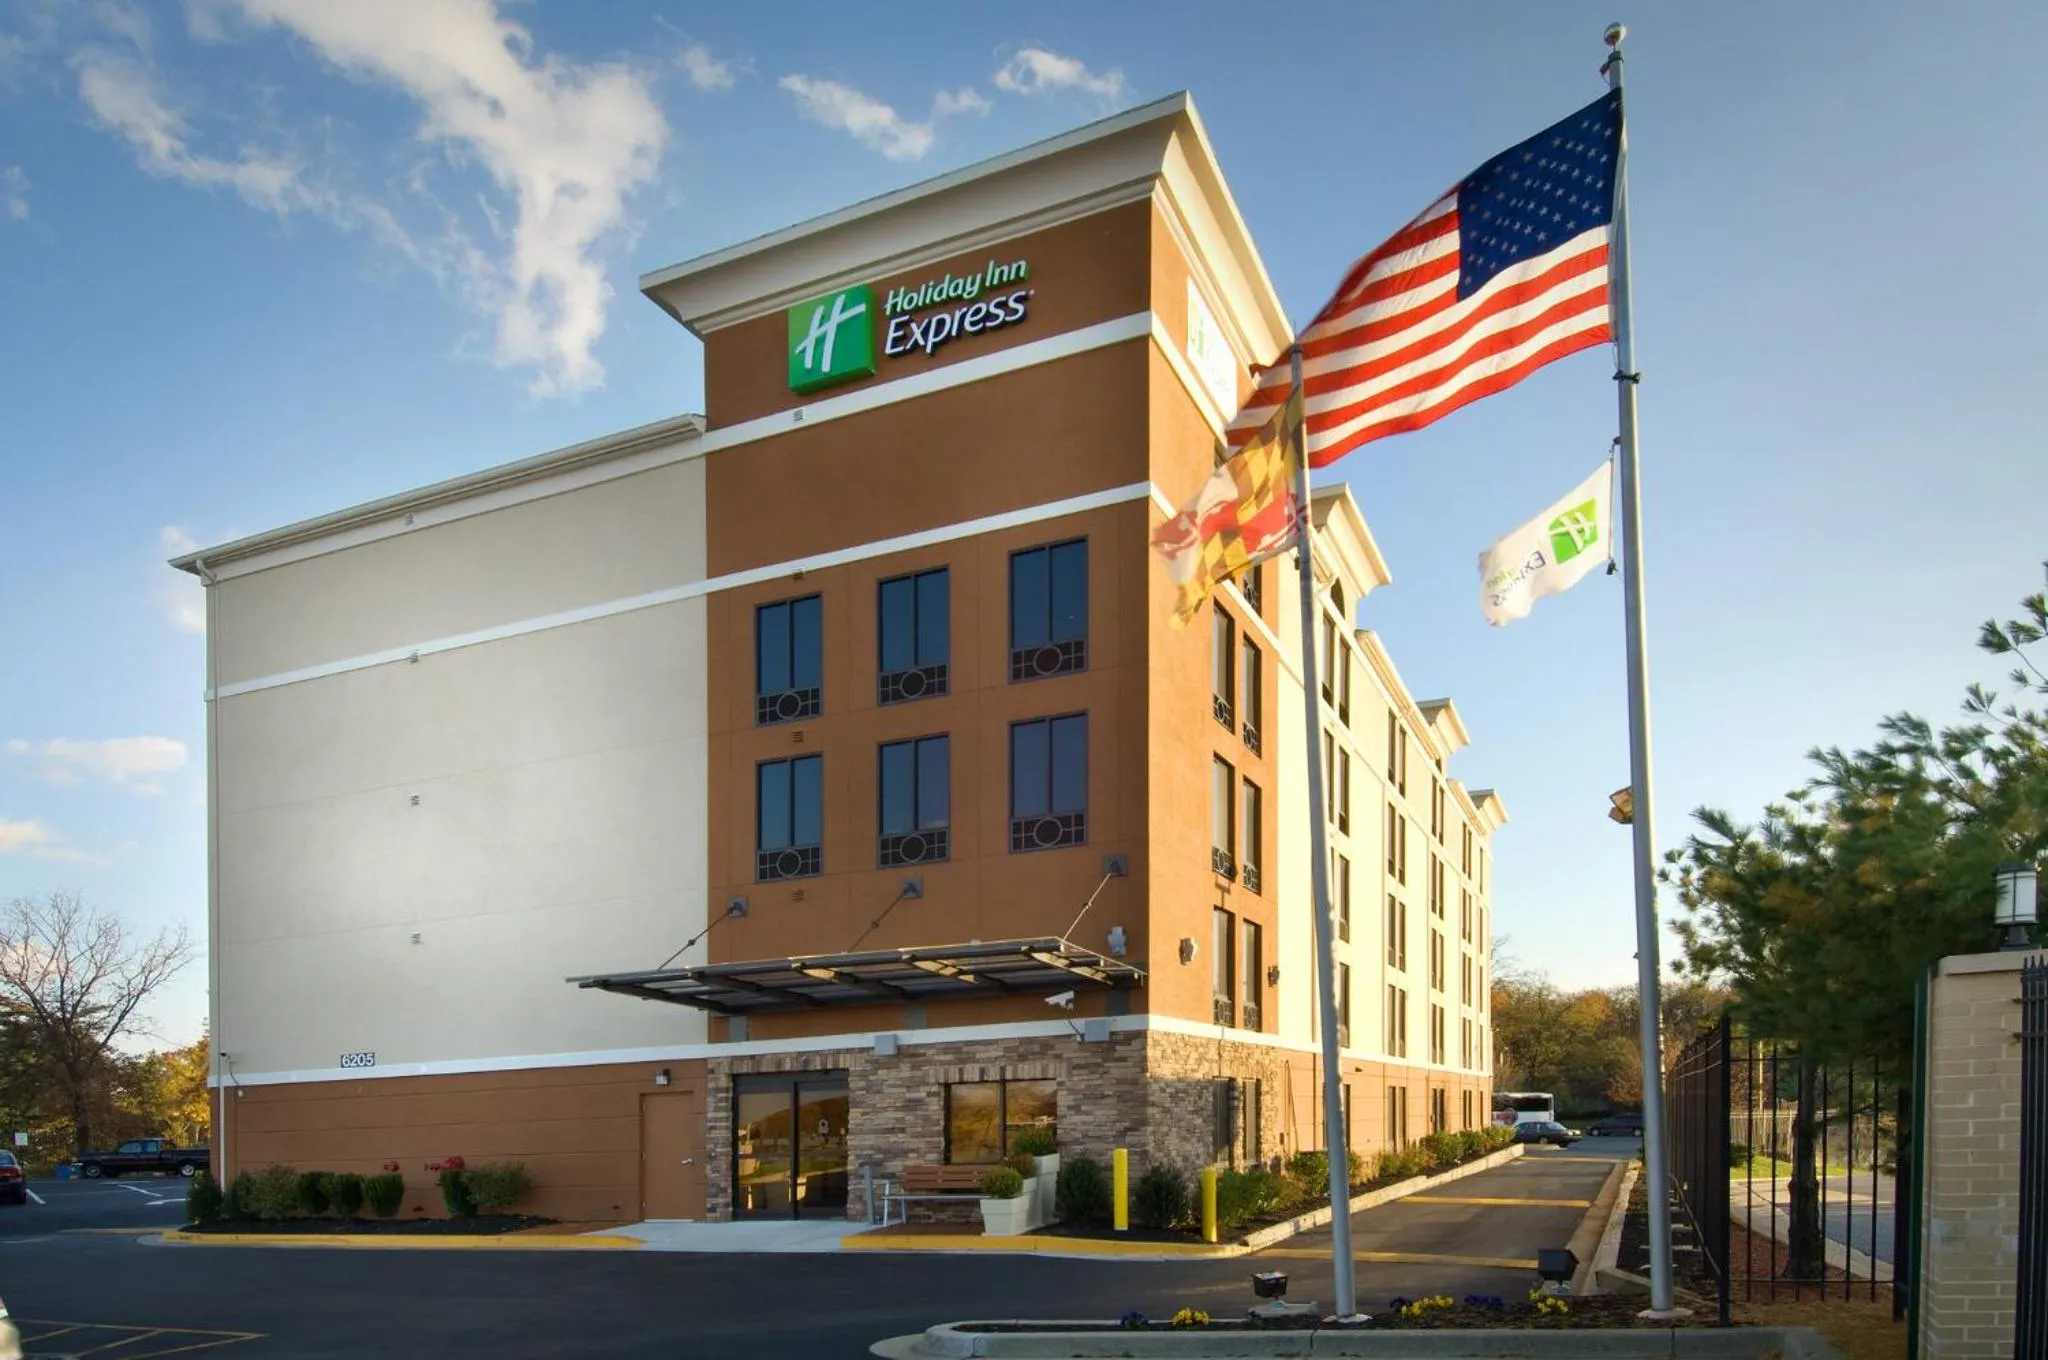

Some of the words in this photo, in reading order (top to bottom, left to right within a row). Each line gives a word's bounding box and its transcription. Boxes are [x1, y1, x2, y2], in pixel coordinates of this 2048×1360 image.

[884, 272, 981, 316] Holiday
[985, 259, 1027, 288] Inn
[884, 290, 1028, 355] Express
[342, 1053, 374, 1067] 6205
